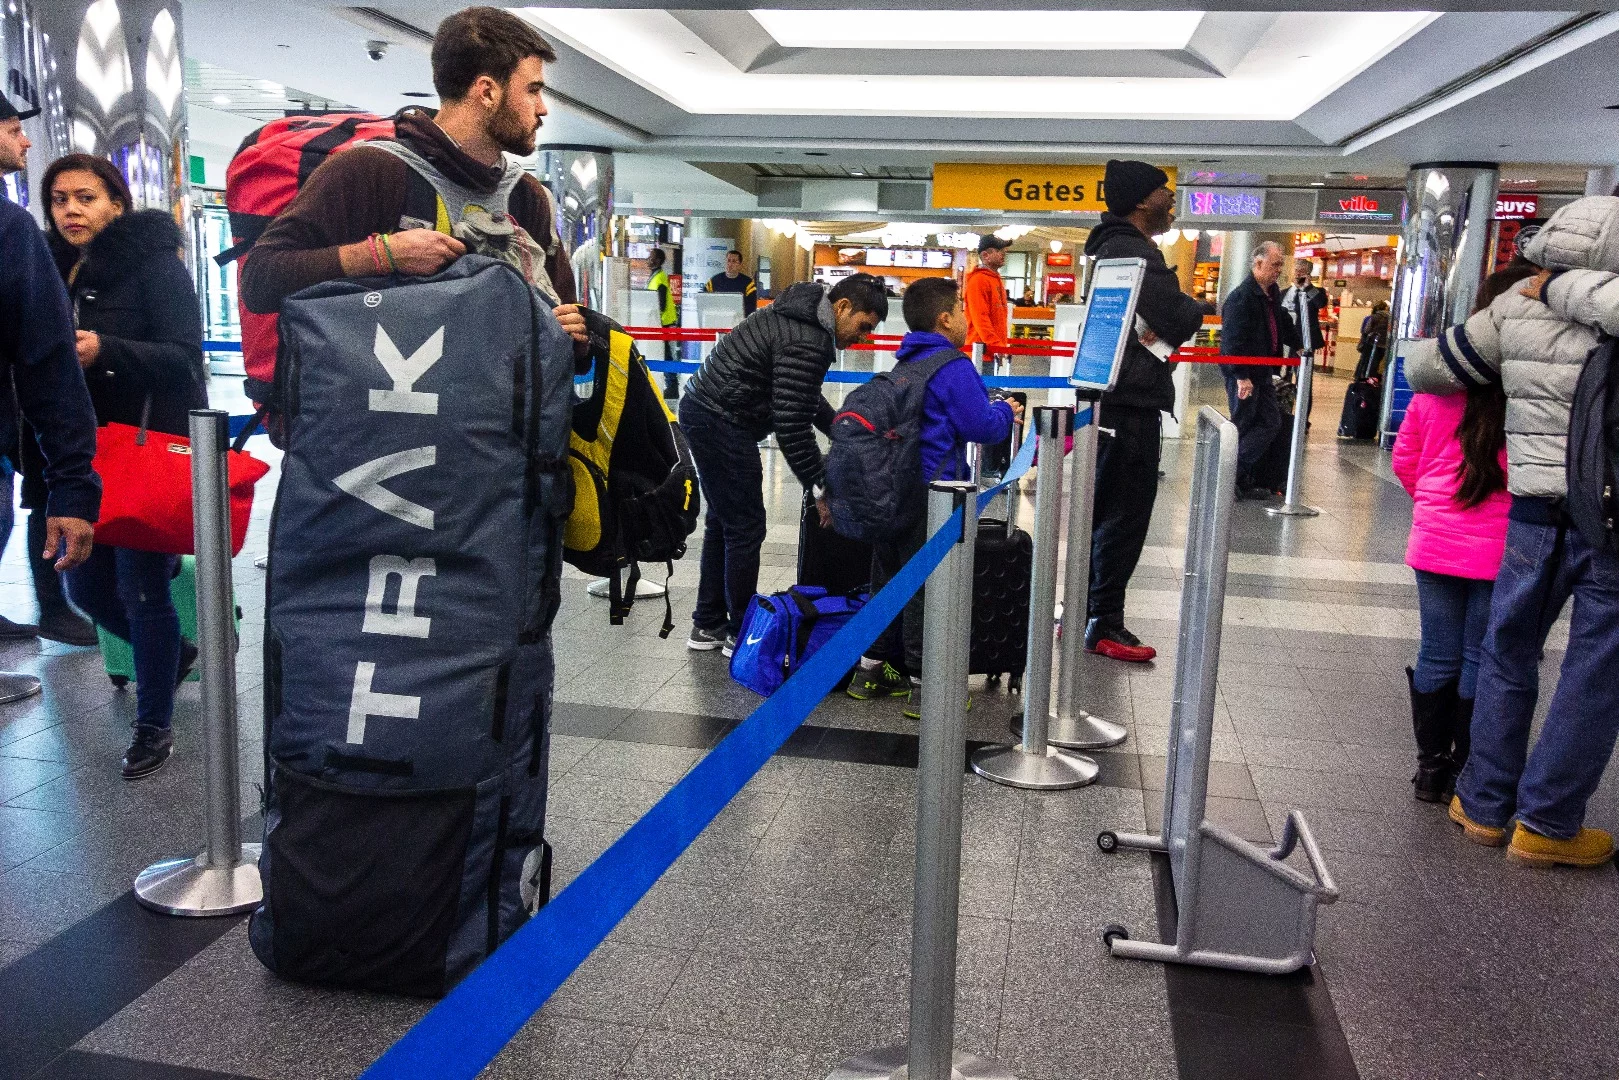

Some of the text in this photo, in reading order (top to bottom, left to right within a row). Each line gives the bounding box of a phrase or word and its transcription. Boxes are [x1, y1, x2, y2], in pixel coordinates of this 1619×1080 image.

[1004, 178, 1085, 202] Gates
[1338, 195, 1379, 212] villa
[1494, 200, 1536, 213] GUYS
[332, 322, 446, 746] TRAK
